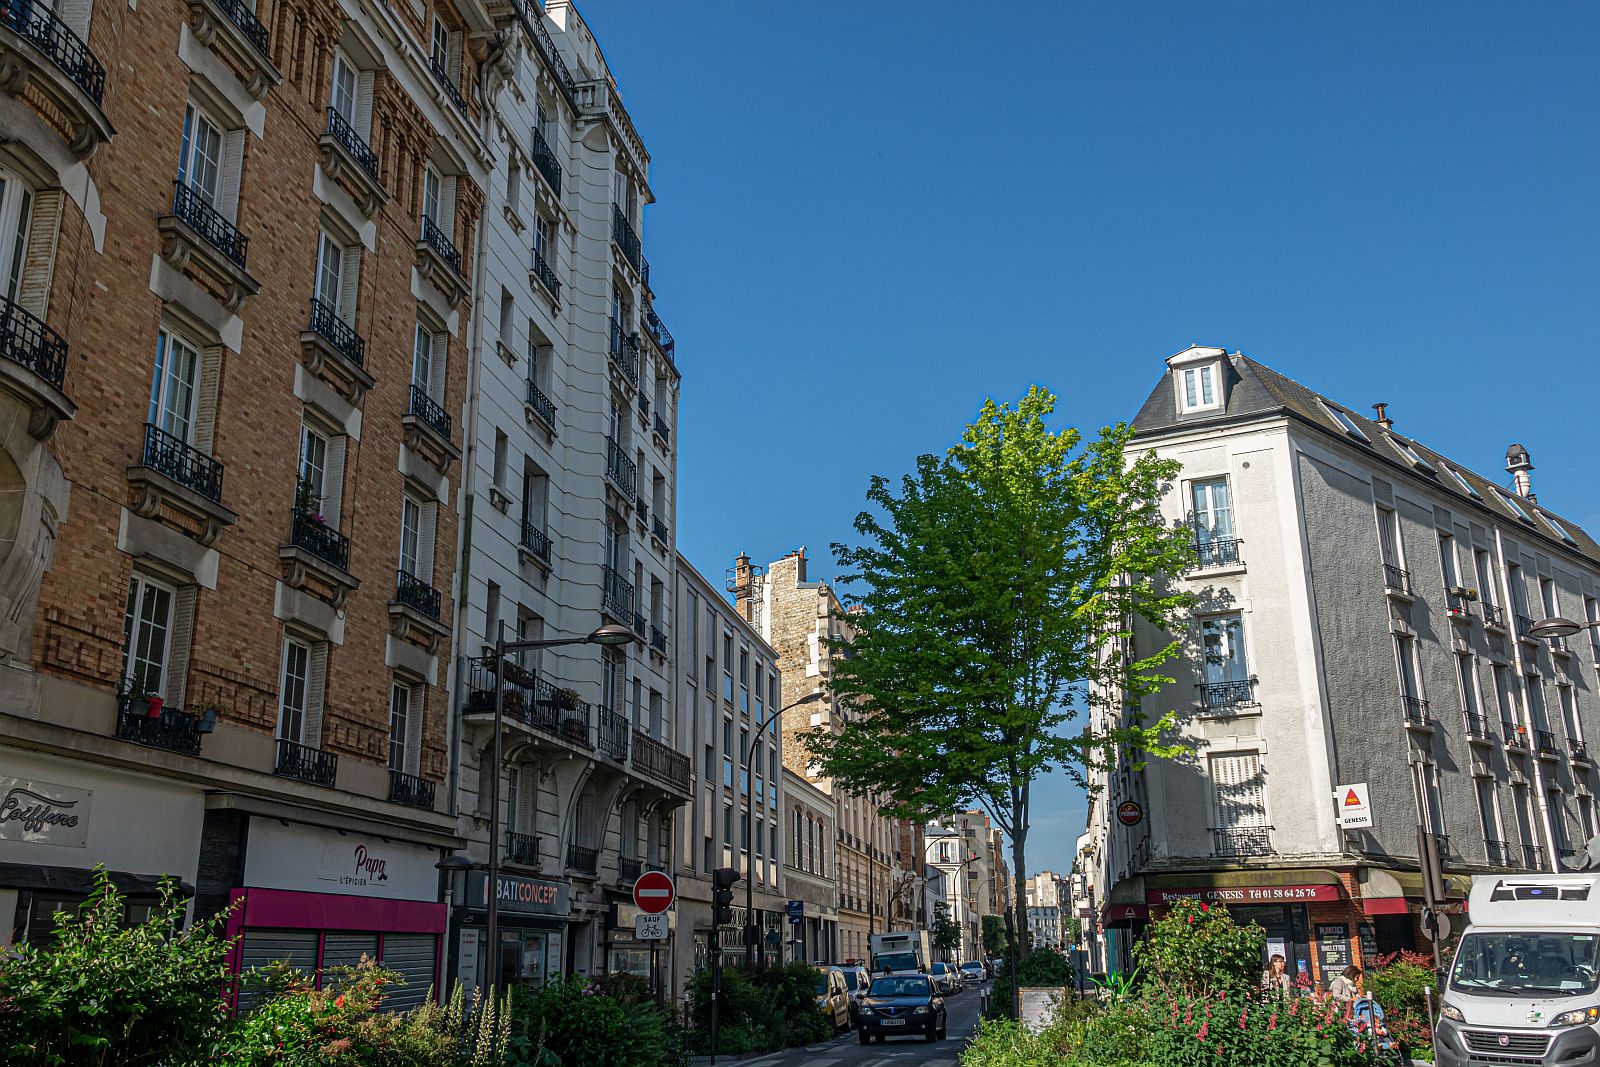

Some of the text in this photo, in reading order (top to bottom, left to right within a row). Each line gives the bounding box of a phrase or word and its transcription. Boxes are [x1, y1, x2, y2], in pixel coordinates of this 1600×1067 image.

[0, 788, 79, 832] Coiffure
[1344, 816, 1368, 824] GENESIS
[354, 844, 388, 881] Papa
[1207, 890, 1244, 900] GENESIS
[1249, 889, 1261, 899] Tél
[1263, 889, 1271, 898] 01
[1273, 889, 1283, 898] 58
[1284, 889, 1294, 898] 64
[1295, 888, 1305, 898] 26
[1306, 888, 1316, 897] 76
